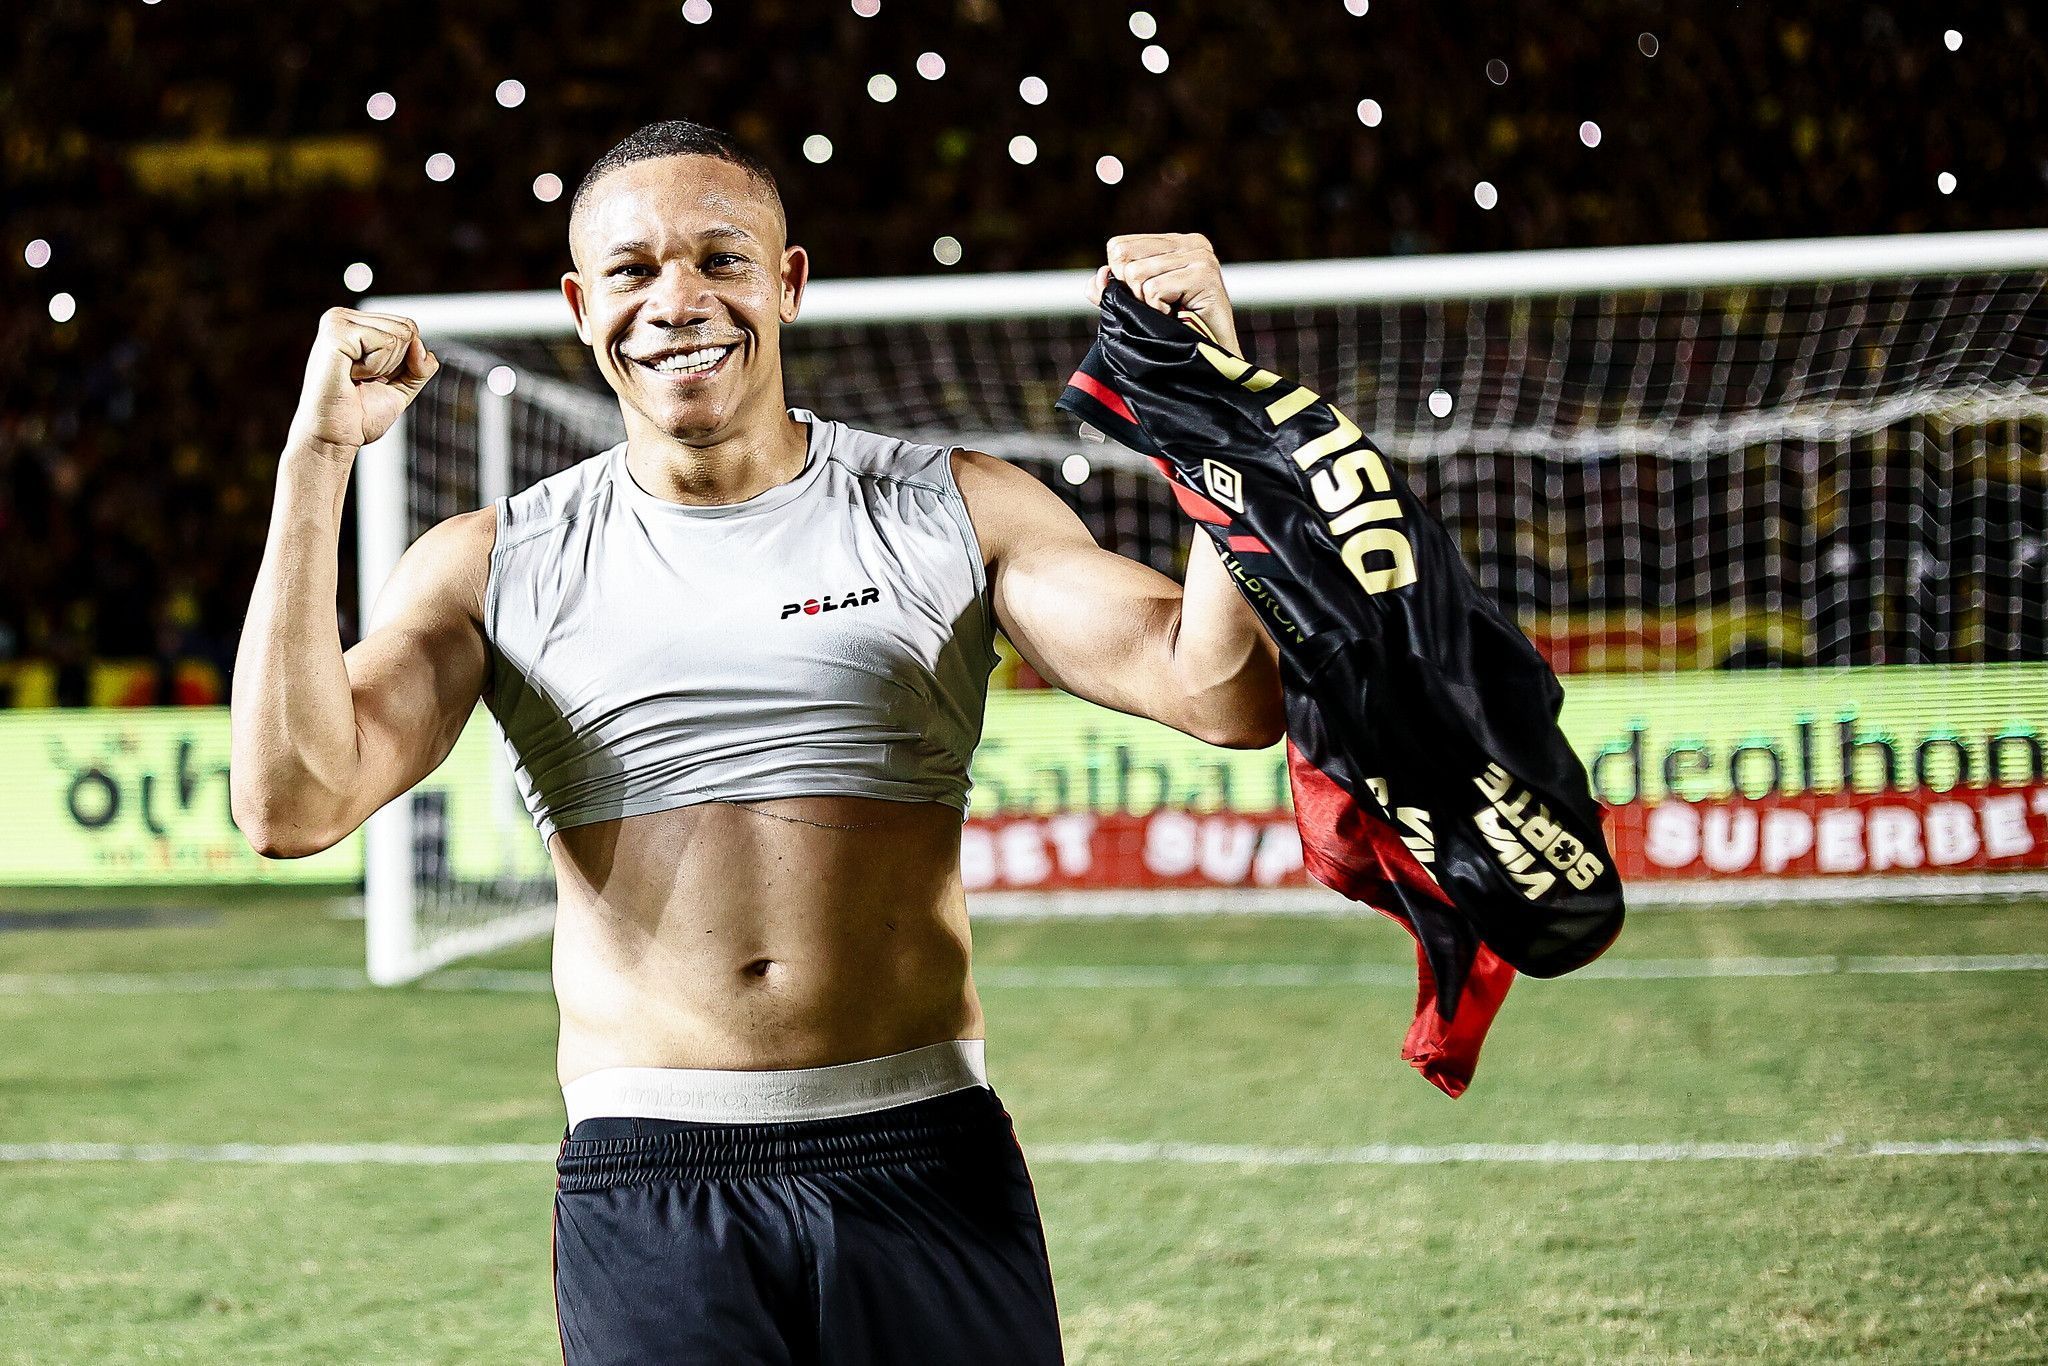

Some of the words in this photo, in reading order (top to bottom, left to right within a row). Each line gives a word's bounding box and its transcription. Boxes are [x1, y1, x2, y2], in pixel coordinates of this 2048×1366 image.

[781, 587, 880, 620] POLAR
[1472, 762, 1604, 891] SORTE
[1473, 806, 1556, 900] VIVA
